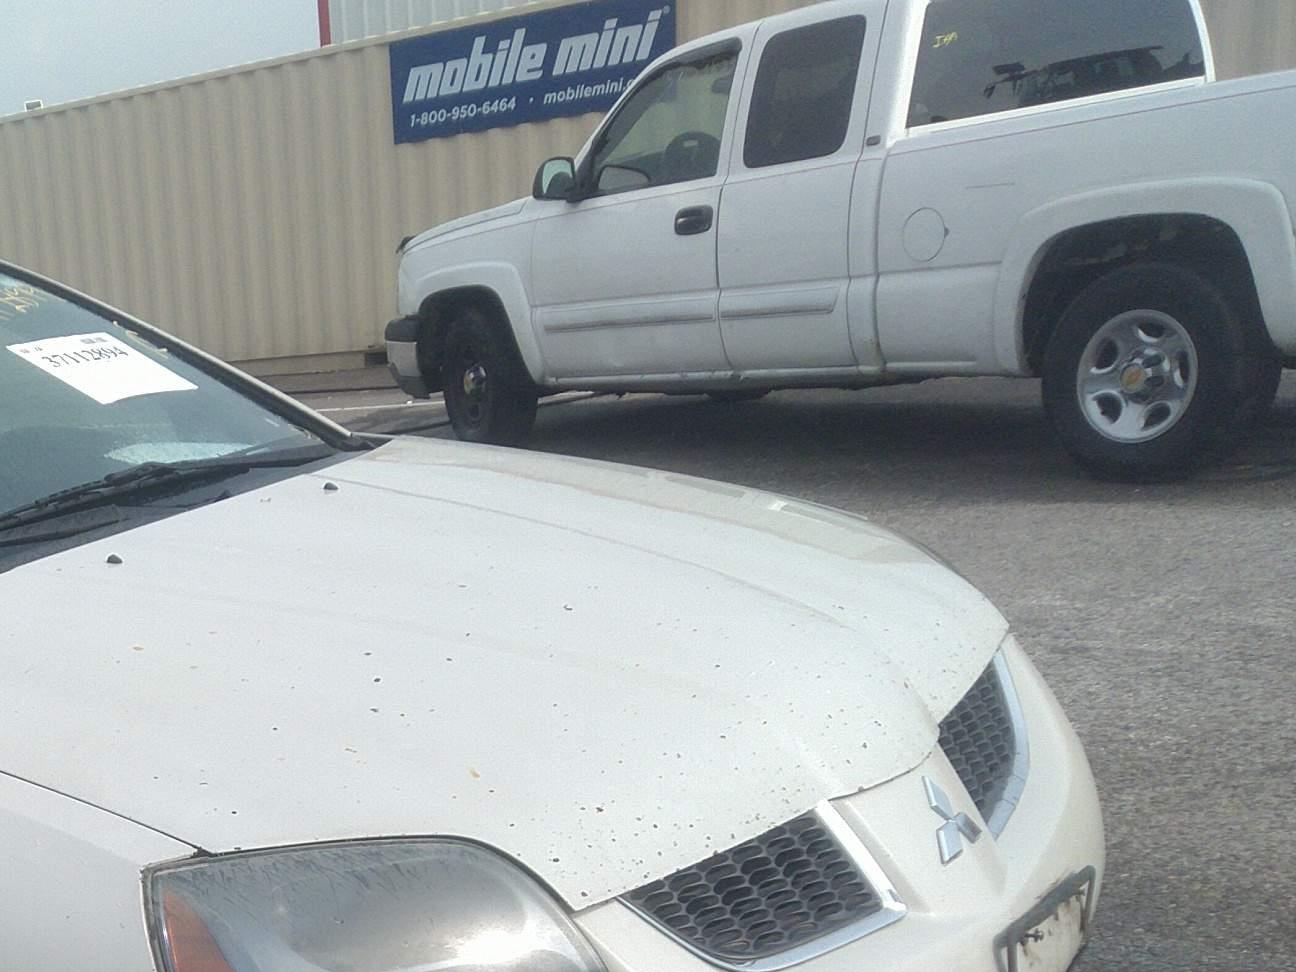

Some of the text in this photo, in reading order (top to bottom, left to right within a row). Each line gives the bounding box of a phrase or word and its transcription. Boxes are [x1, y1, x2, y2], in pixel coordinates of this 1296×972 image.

[402, 9, 663, 103] mobile mini
[410, 97, 516, 128] 1-800-950-6464
[41, 346, 129, 368] 37112894
